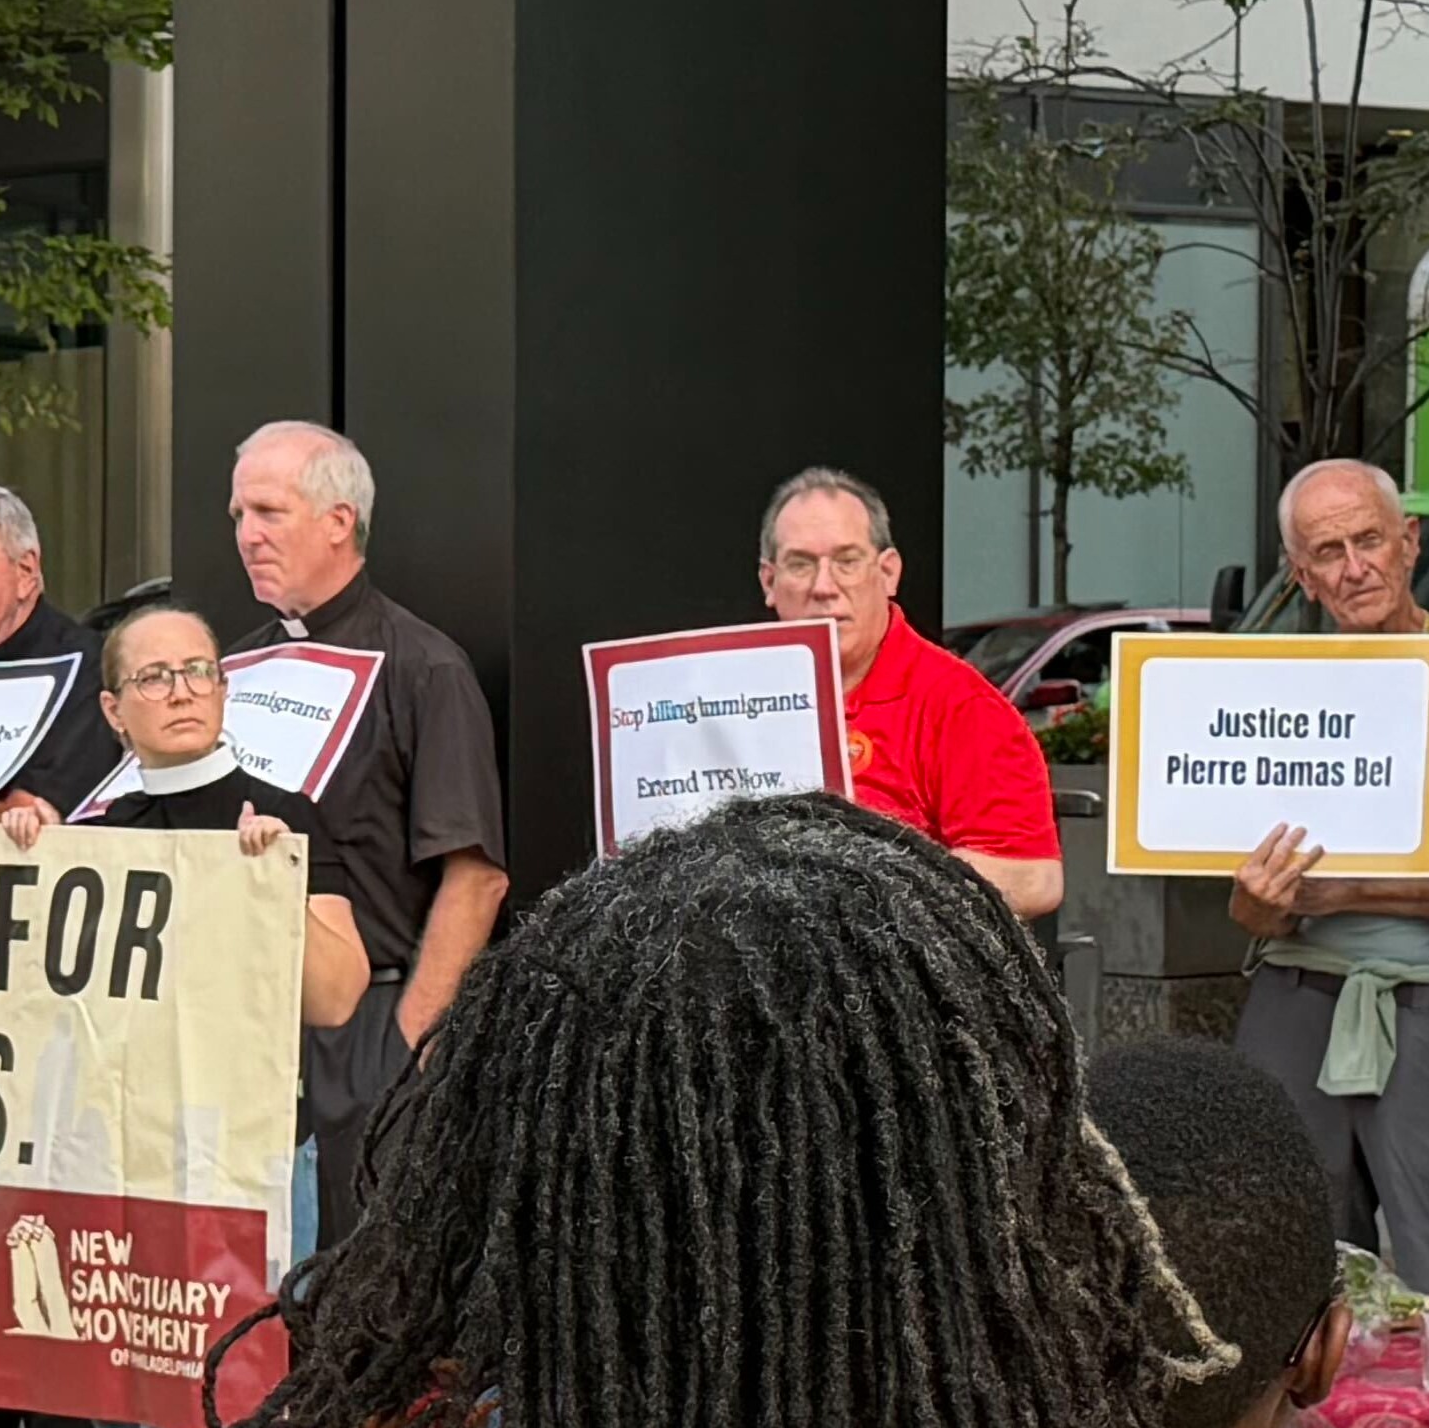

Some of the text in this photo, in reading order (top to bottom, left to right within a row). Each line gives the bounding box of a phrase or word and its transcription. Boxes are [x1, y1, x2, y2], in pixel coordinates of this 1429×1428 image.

[612, 708, 644, 731] Stop
[1209, 707, 1355, 739] Justice for
[702, 769, 735, 790] TPS
[1167, 753, 1393, 787] Pierre Damas Bel
[71, 1229, 133, 1265] NEW
[71, 1269, 231, 1318] SANCTUARY
[71, 1307, 209, 1357] MOVEMENT
